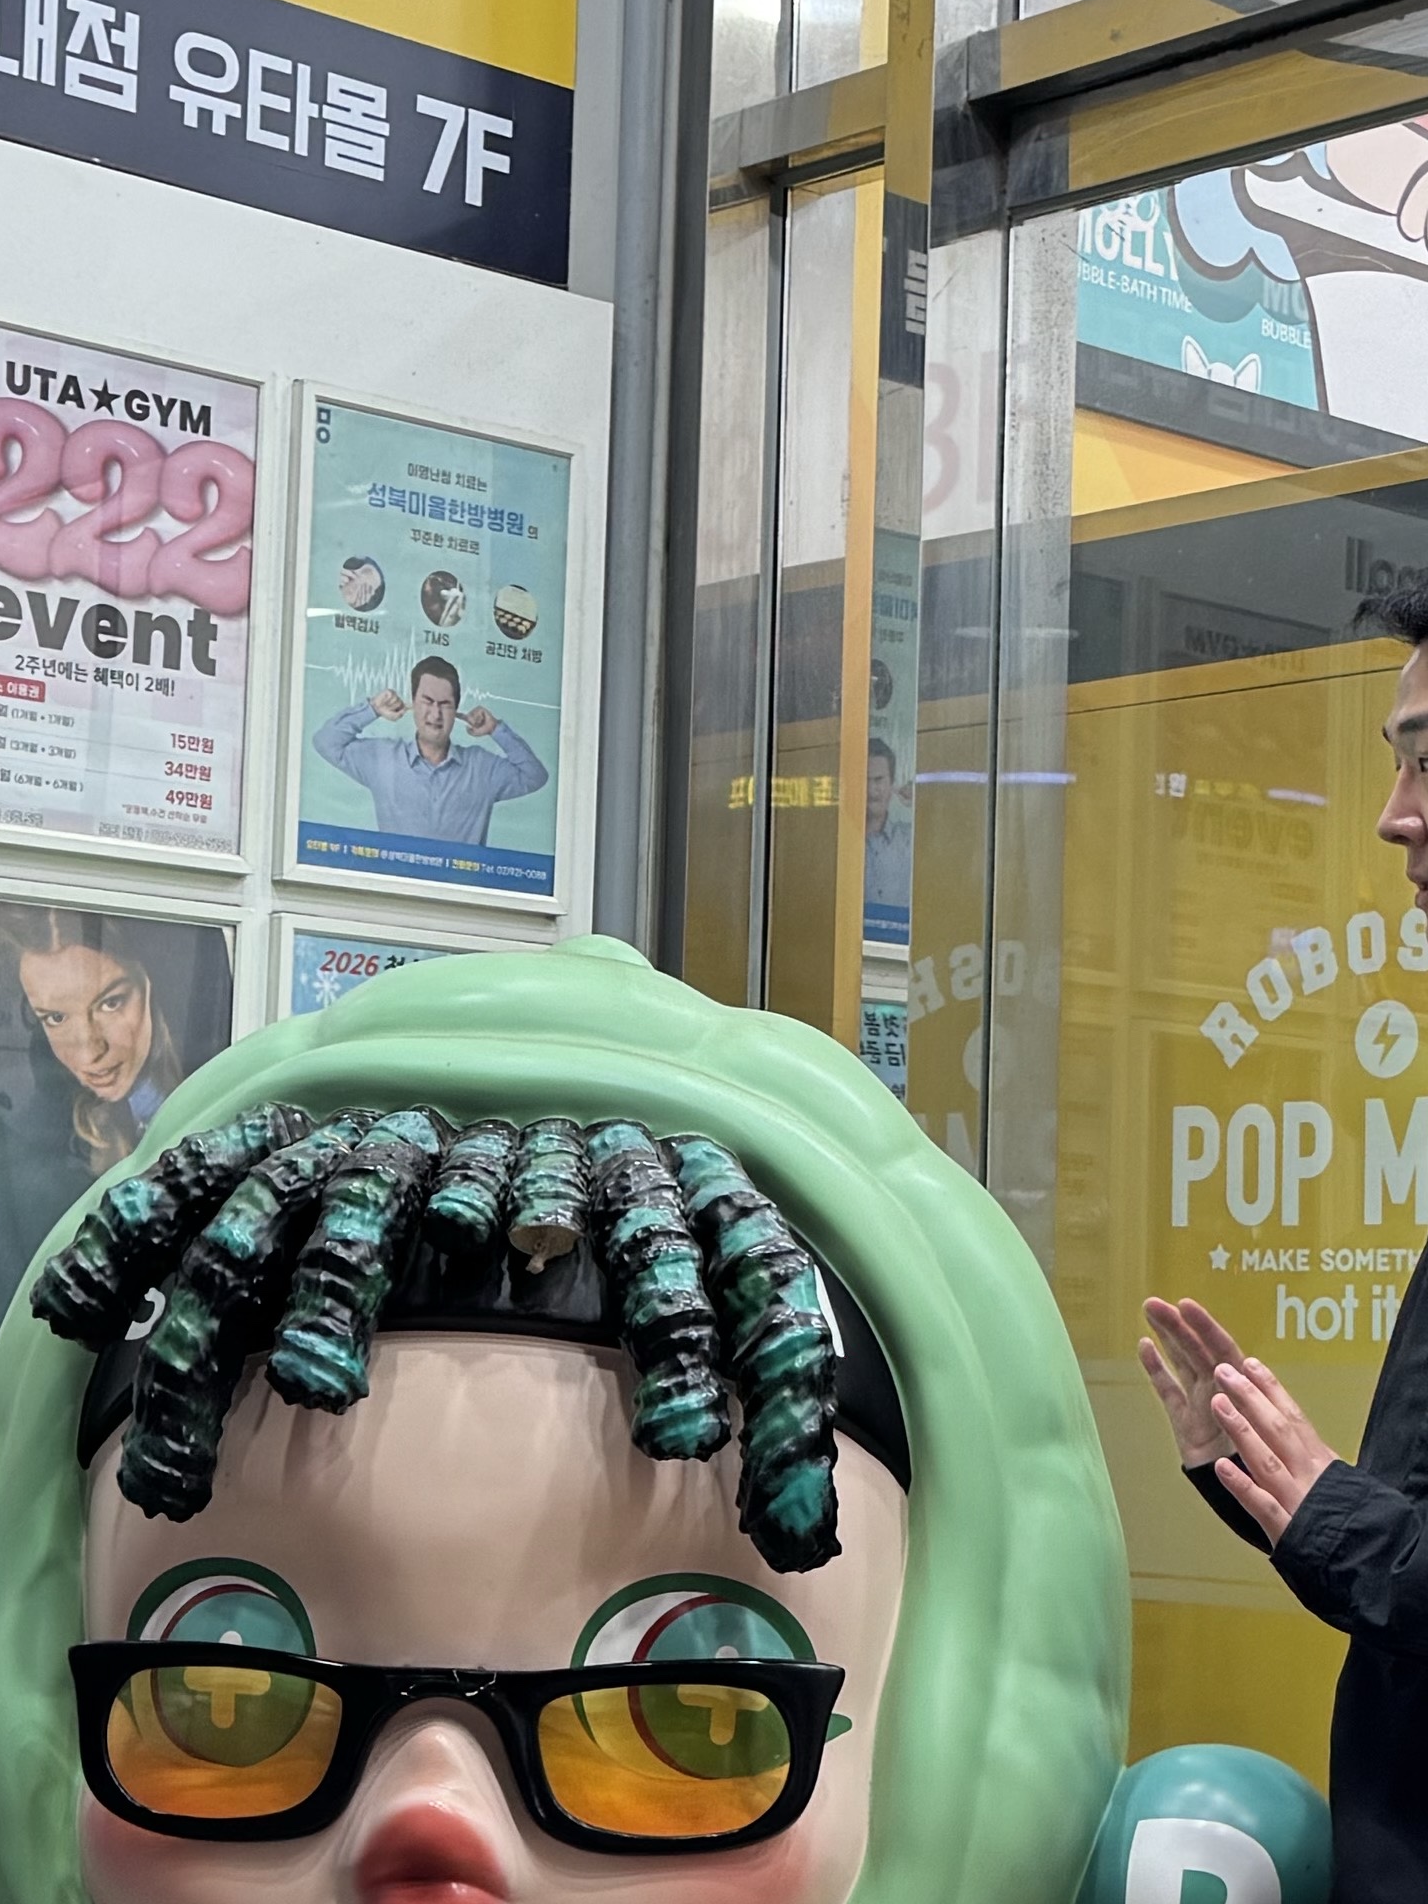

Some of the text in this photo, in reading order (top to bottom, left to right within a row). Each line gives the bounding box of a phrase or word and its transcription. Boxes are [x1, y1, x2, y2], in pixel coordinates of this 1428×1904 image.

[172, 30, 390, 185] 유타몰
[415, 94, 513, 206] 7F
[423, 629, 450, 648] TMS
[485, 640, 518, 661] 공진단
[14, 654, 176, 697] 2주년에는 혜택이 2배!
[170, 732, 215, 754] 15만원
[163, 760, 213, 783] 34만원
[164, 788, 214, 812] 49만원
[319, 950, 381, 977] 2026
[1172, 1100, 1334, 1227] POP
[1241, 1247, 1311, 1272] MAKE
[1276, 1283, 1404, 1342] hot it
